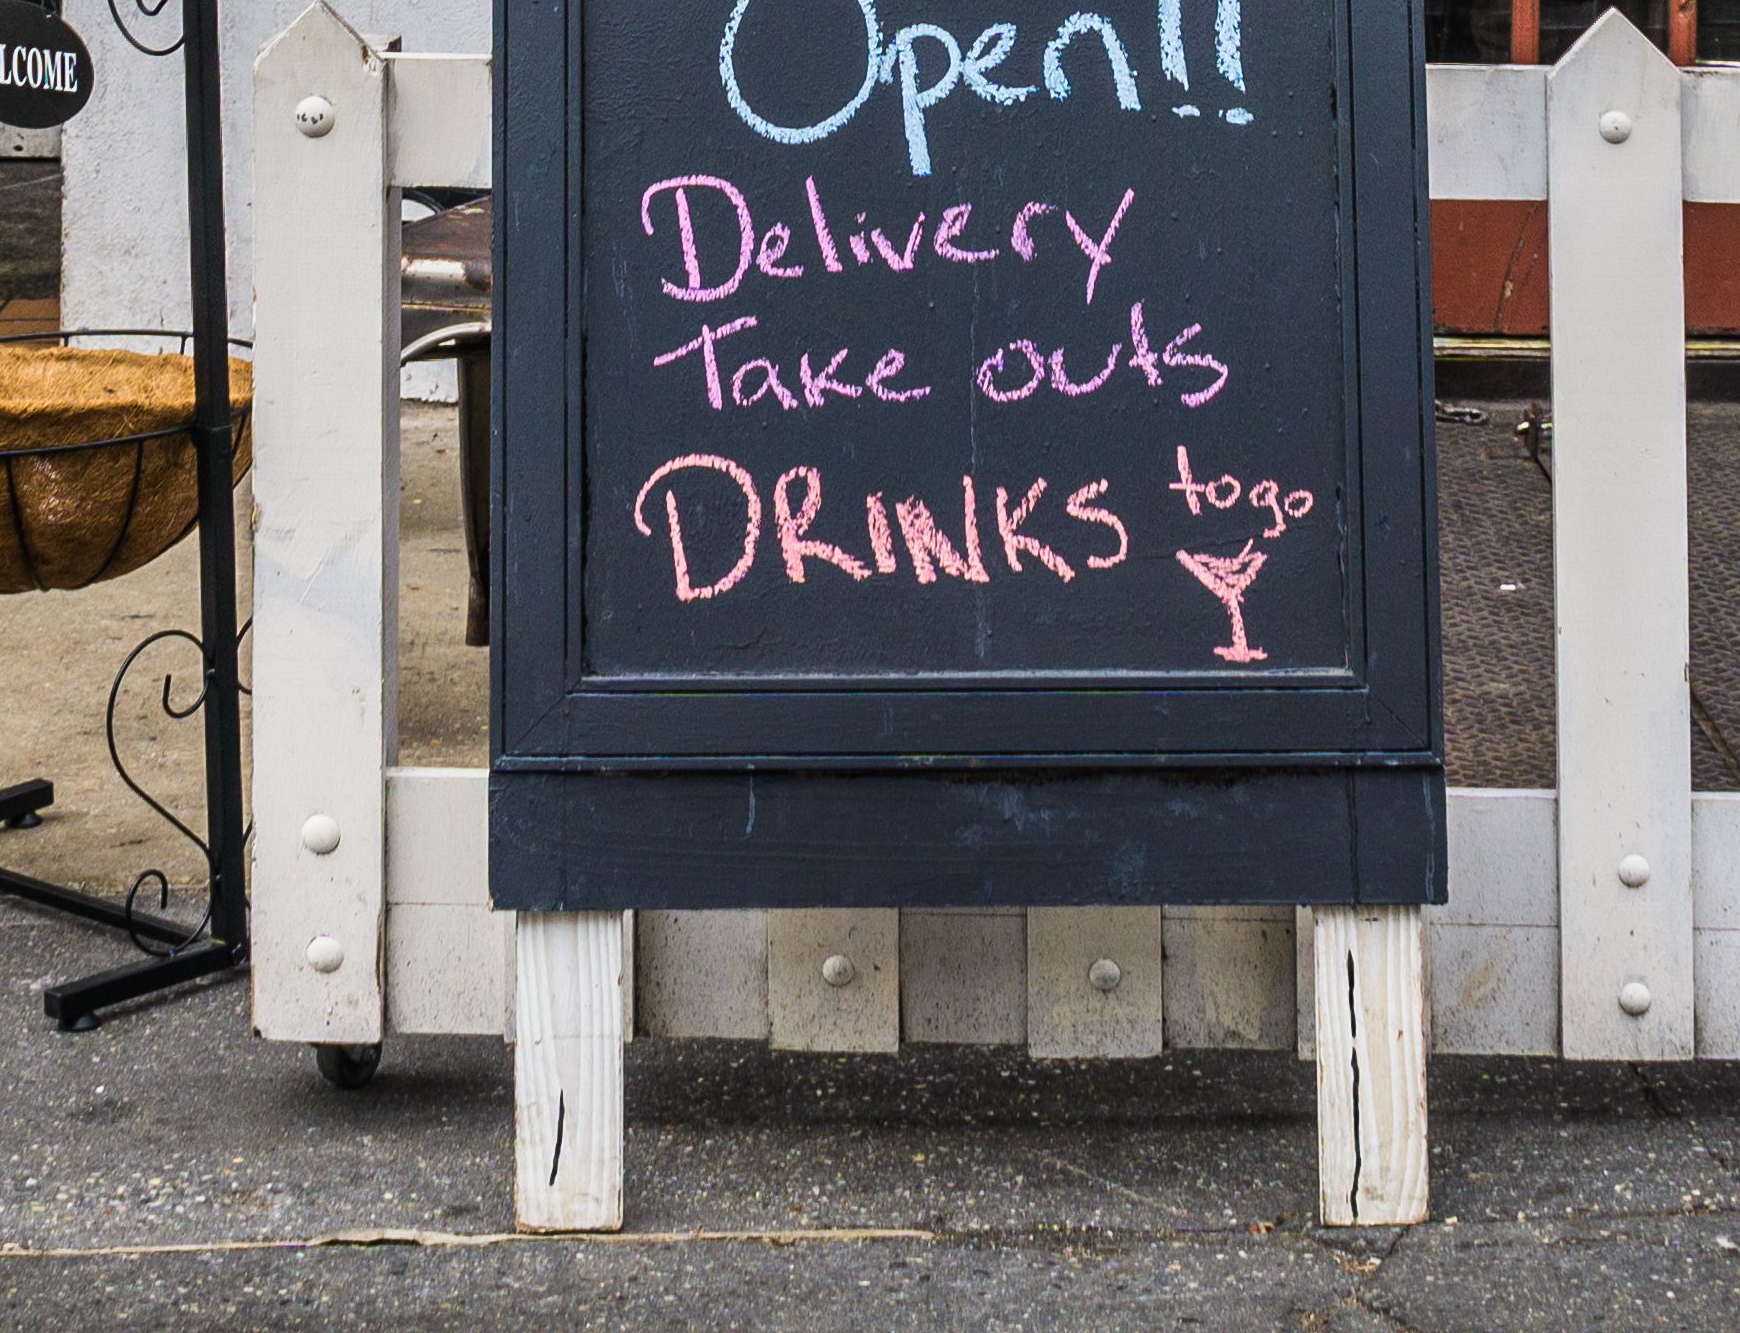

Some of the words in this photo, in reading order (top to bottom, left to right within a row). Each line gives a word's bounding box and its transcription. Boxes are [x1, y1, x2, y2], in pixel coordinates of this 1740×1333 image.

[641, 175, 1134, 304] Delivery
[654, 316, 931, 410] Take
[977, 302, 1228, 406] outs
[634, 453, 1128, 603] DRINKS
